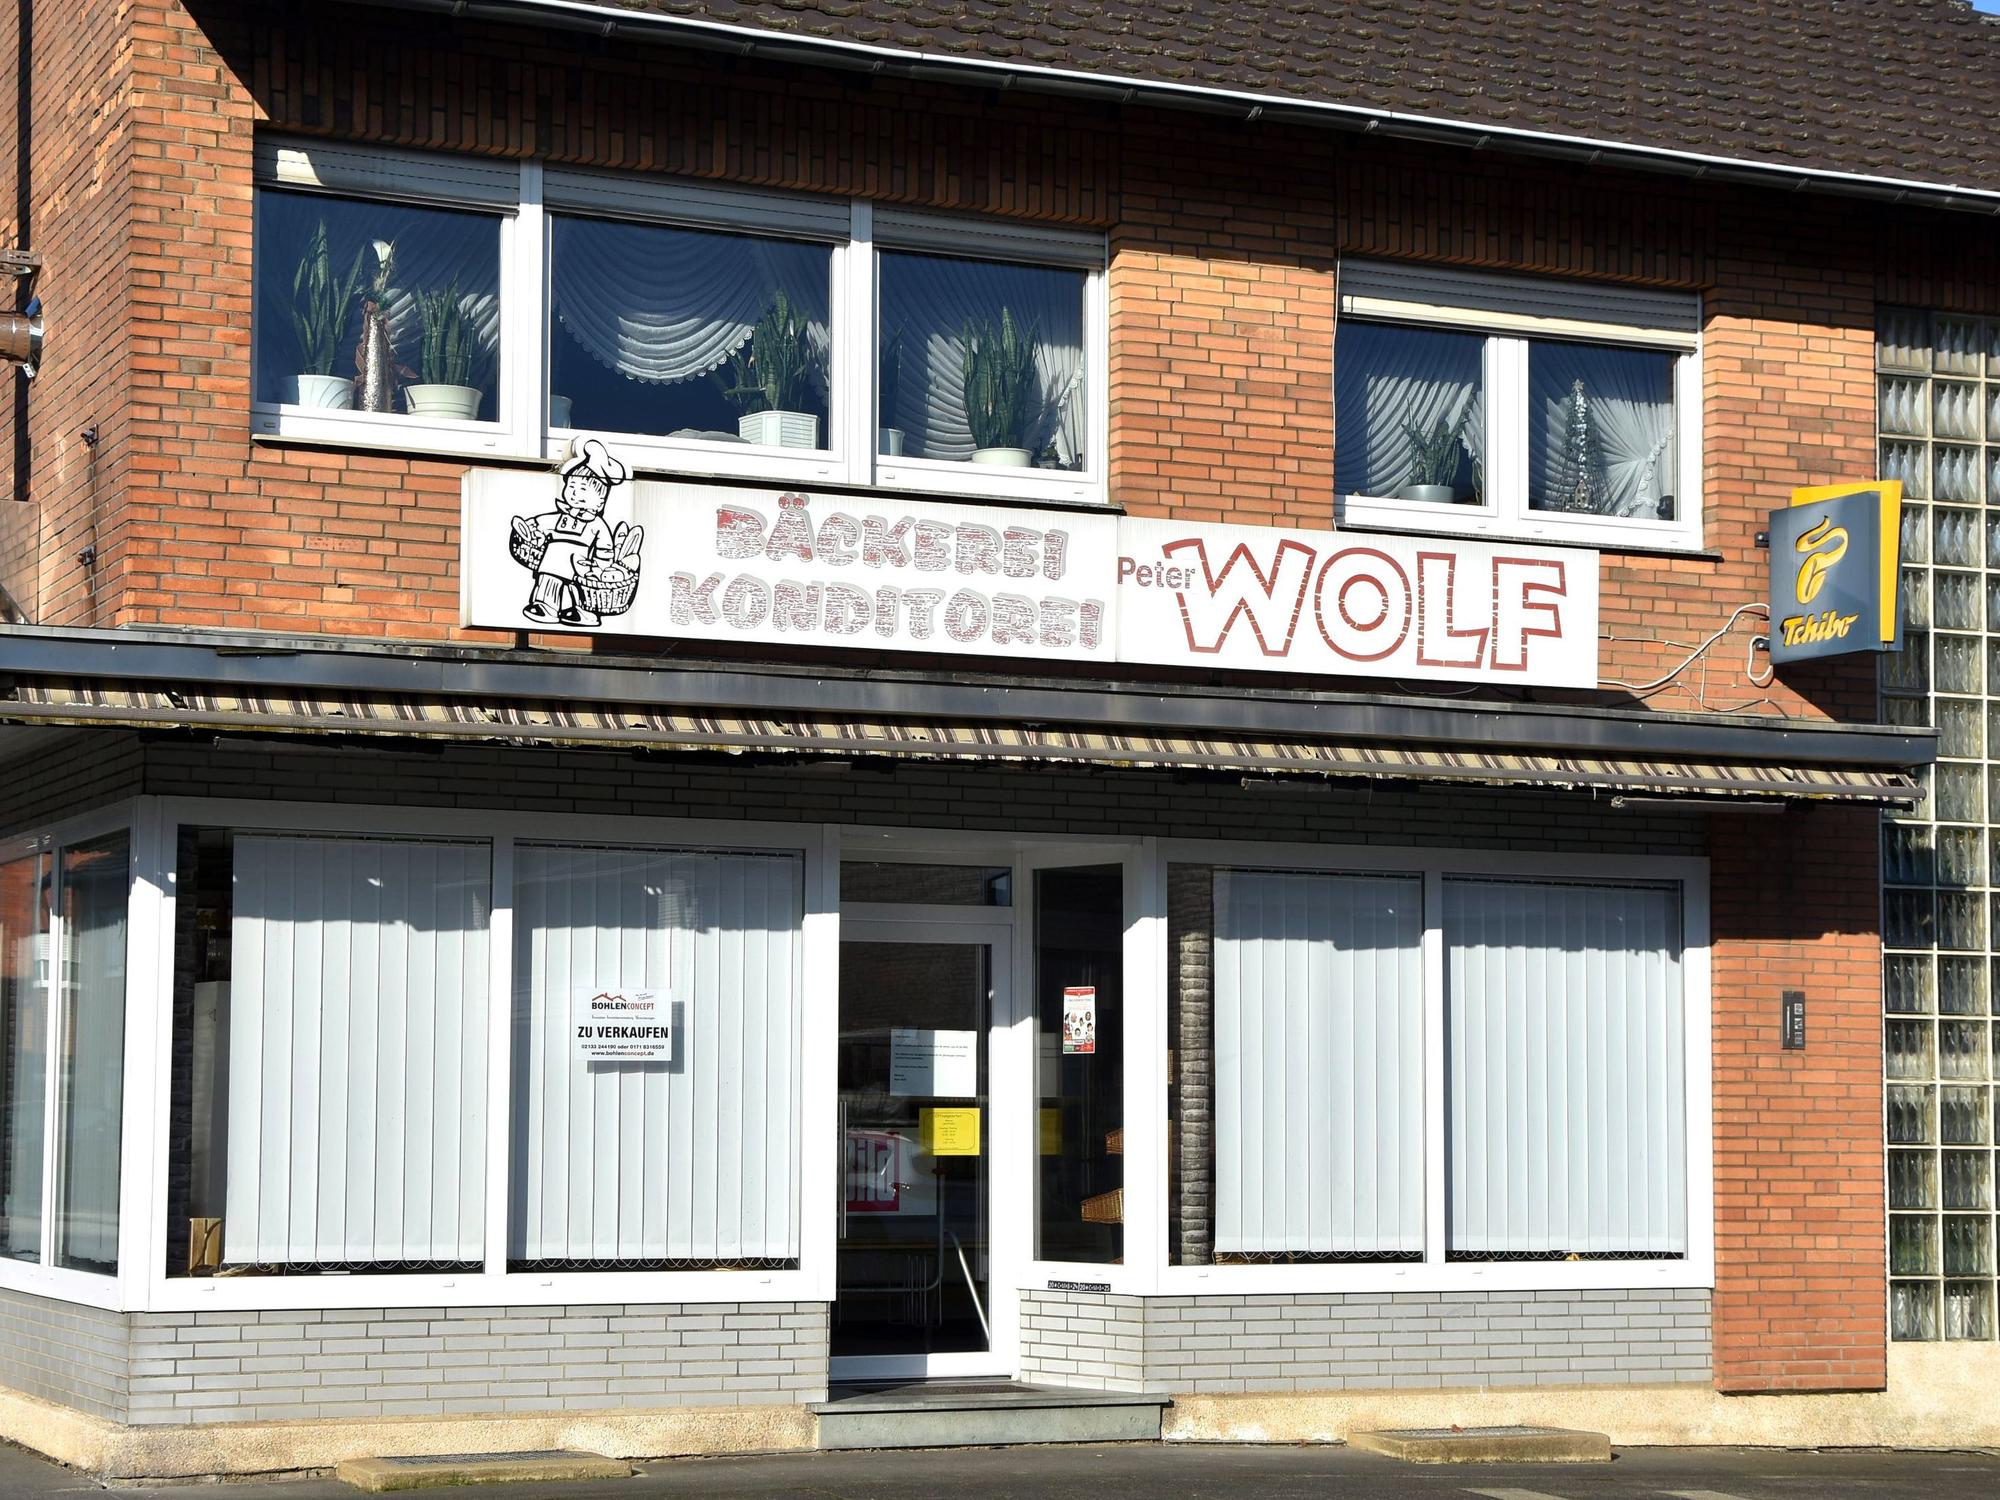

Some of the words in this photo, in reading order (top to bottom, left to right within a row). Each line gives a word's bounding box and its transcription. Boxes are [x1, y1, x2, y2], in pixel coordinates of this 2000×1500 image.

[715, 493, 1069, 580] BÄCKEREI
[667, 570, 1105, 650] KONDITOREI
[1117, 556, 1196, 589] Peter
[1161, 538, 1567, 671] WOLF
[1780, 609, 1859, 647] Tchibo
[578, 1026, 593, 1038] ZU
[597, 1026, 669, 1038] VERKAUFEN
